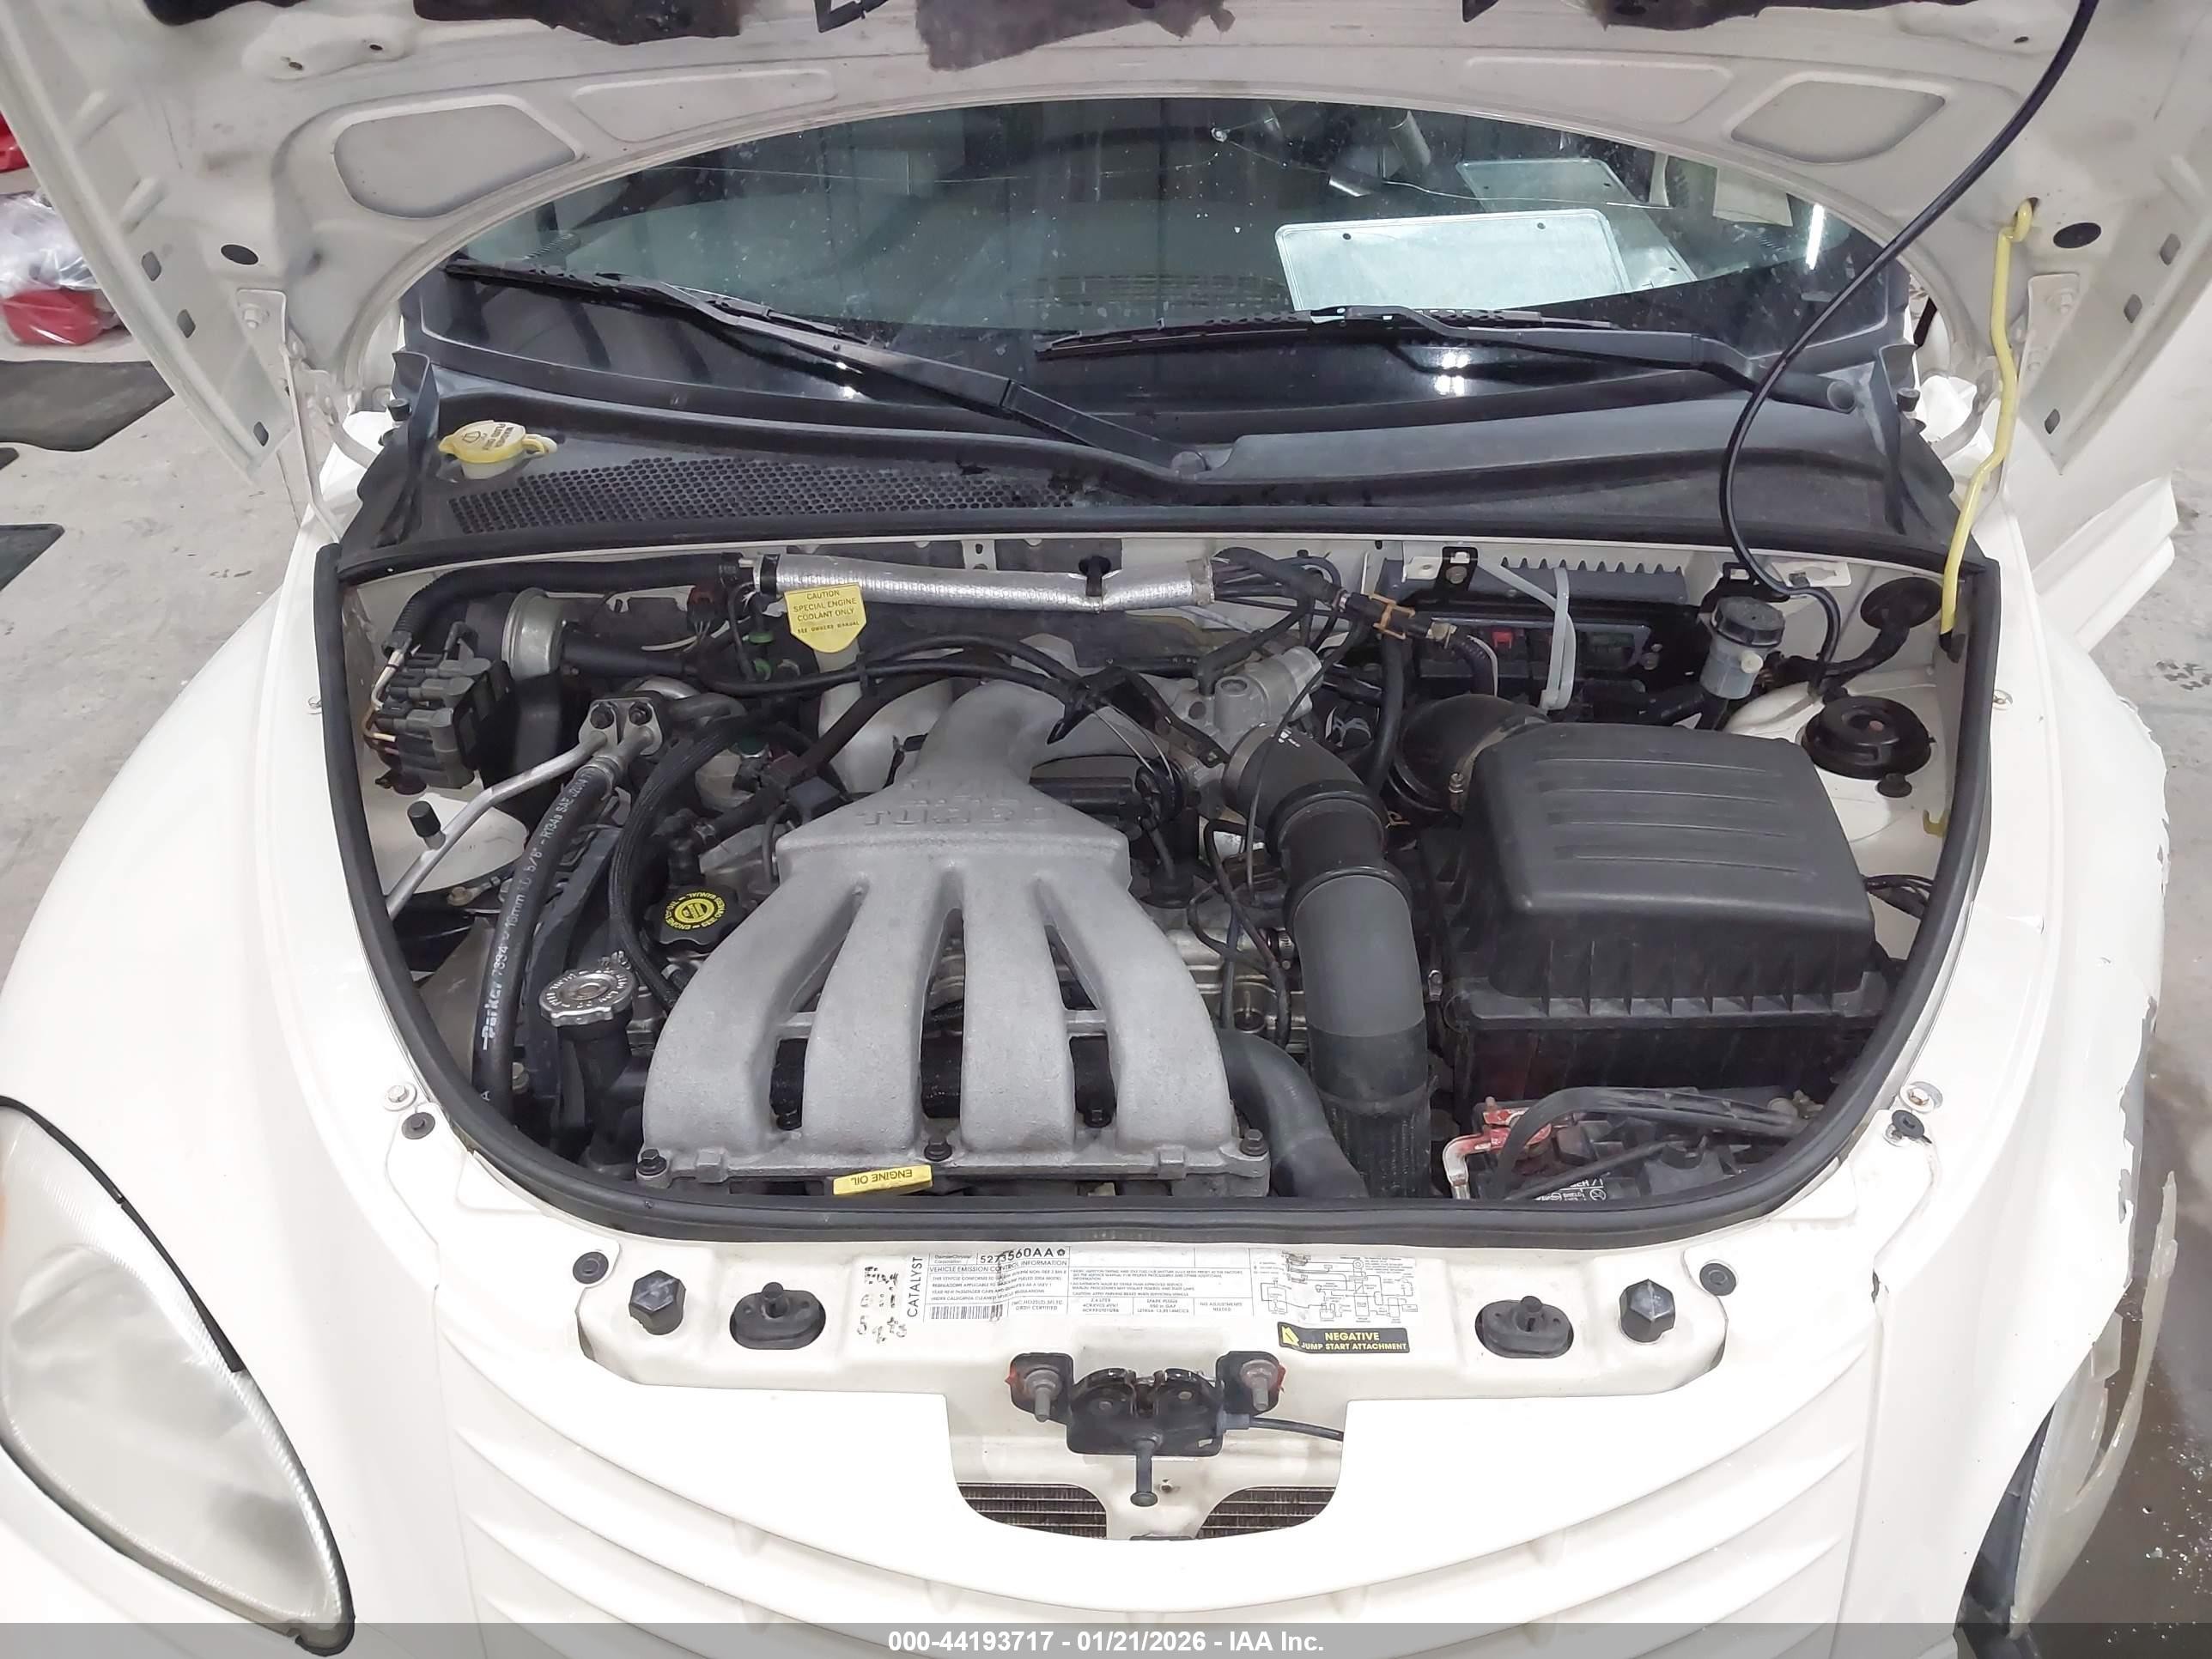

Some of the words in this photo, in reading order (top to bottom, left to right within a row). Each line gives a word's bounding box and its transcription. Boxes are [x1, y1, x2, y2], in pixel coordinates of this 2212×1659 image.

[807, 590, 840, 600] CAUTION
[793, 601, 825, 613] SPECIAL
[827, 597, 857, 609] ENGINE
[797, 611, 833, 622] COOLANT
[836, 607, 854, 617] ONLY
[482, 981, 502, 1038] Parker
[540, 814, 563, 840] R134a
[556, 797, 575, 813] SAE
[850, 1175, 868, 1186] OIL
[871, 1169, 913, 1182] ENGINE
[980, 1248, 1054, 1264] 5273560AA
[989, 1262, 1019, 1272] CONTROL
[907, 1256, 924, 1318] CATALYST
[1325, 1332, 1380, 1341] NEGATIVE
[1301, 1341, 1323, 1350] JUMP
